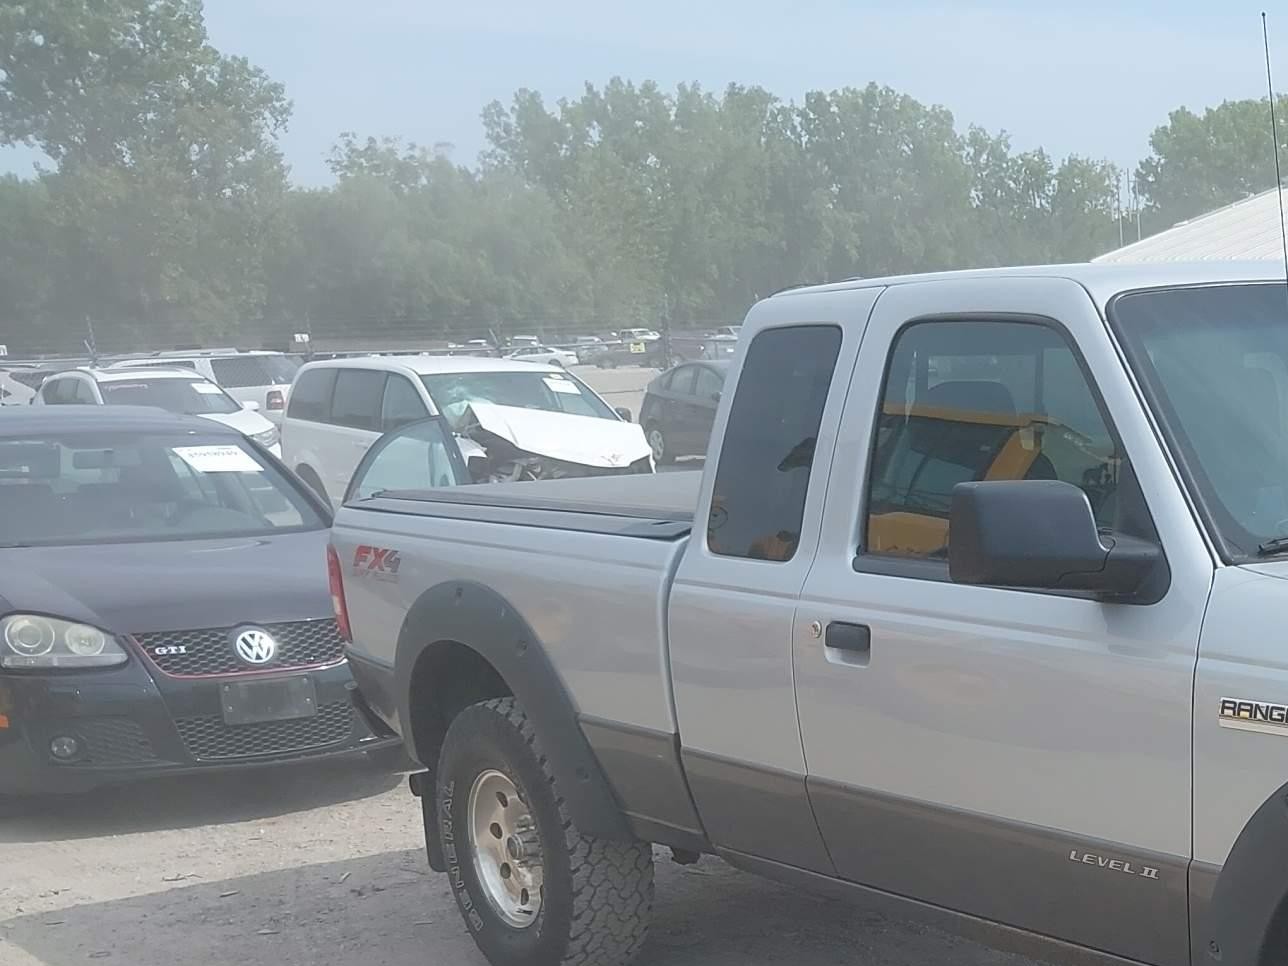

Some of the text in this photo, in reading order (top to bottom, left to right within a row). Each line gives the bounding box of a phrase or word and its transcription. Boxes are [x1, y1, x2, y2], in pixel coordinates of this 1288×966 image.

[352, 544, 401, 574] FX4
[154, 645, 187, 655] GTI
[1069, 850, 1159, 880] LEVEL II
